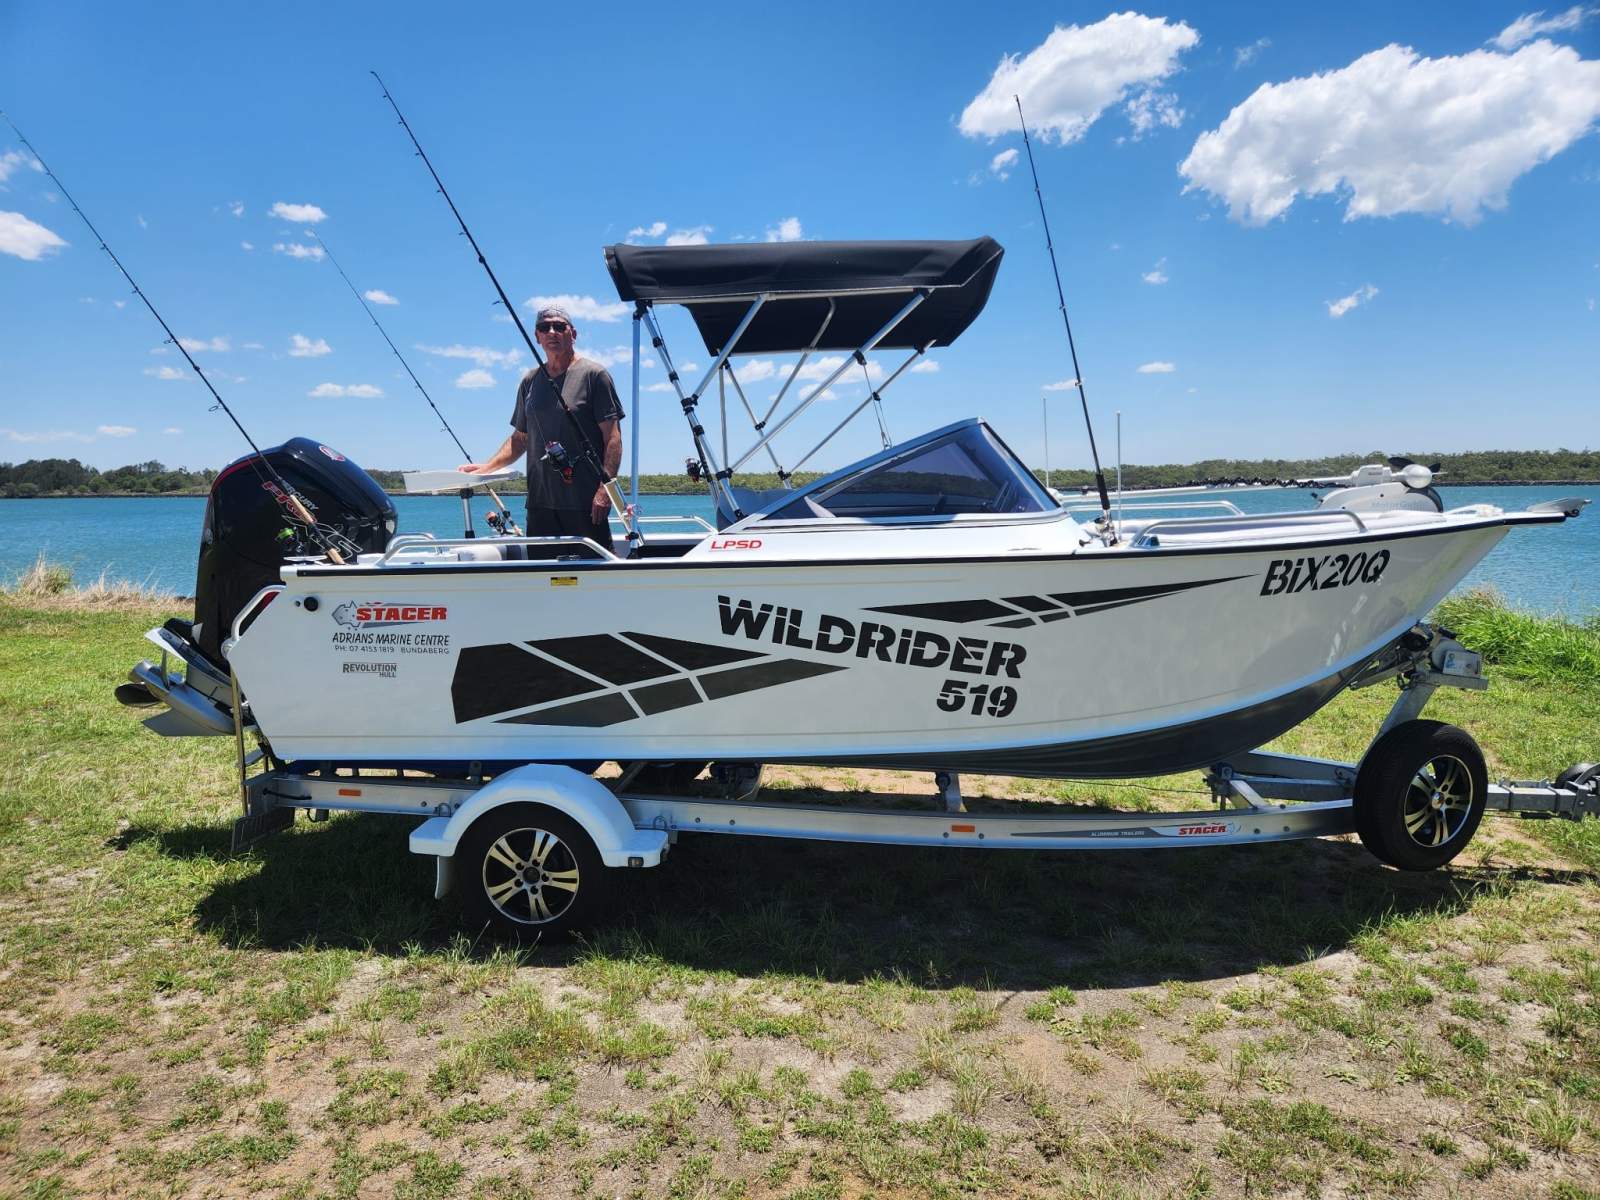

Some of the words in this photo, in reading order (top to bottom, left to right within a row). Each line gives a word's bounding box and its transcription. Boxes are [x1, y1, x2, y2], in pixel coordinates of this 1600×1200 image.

[711, 540, 762, 549] LPSD
[356, 607, 448, 621] STACER
[332, 632, 374, 645] ADRIANS
[375, 633, 412, 646] MARINE
[414, 634, 450, 647] CENTRE
[400, 646, 450, 654] BUNDABERG
[342, 663, 397, 673] REVOLUTION
[936, 679, 1018, 718] 519
[1178, 825, 1227, 836] STACER
